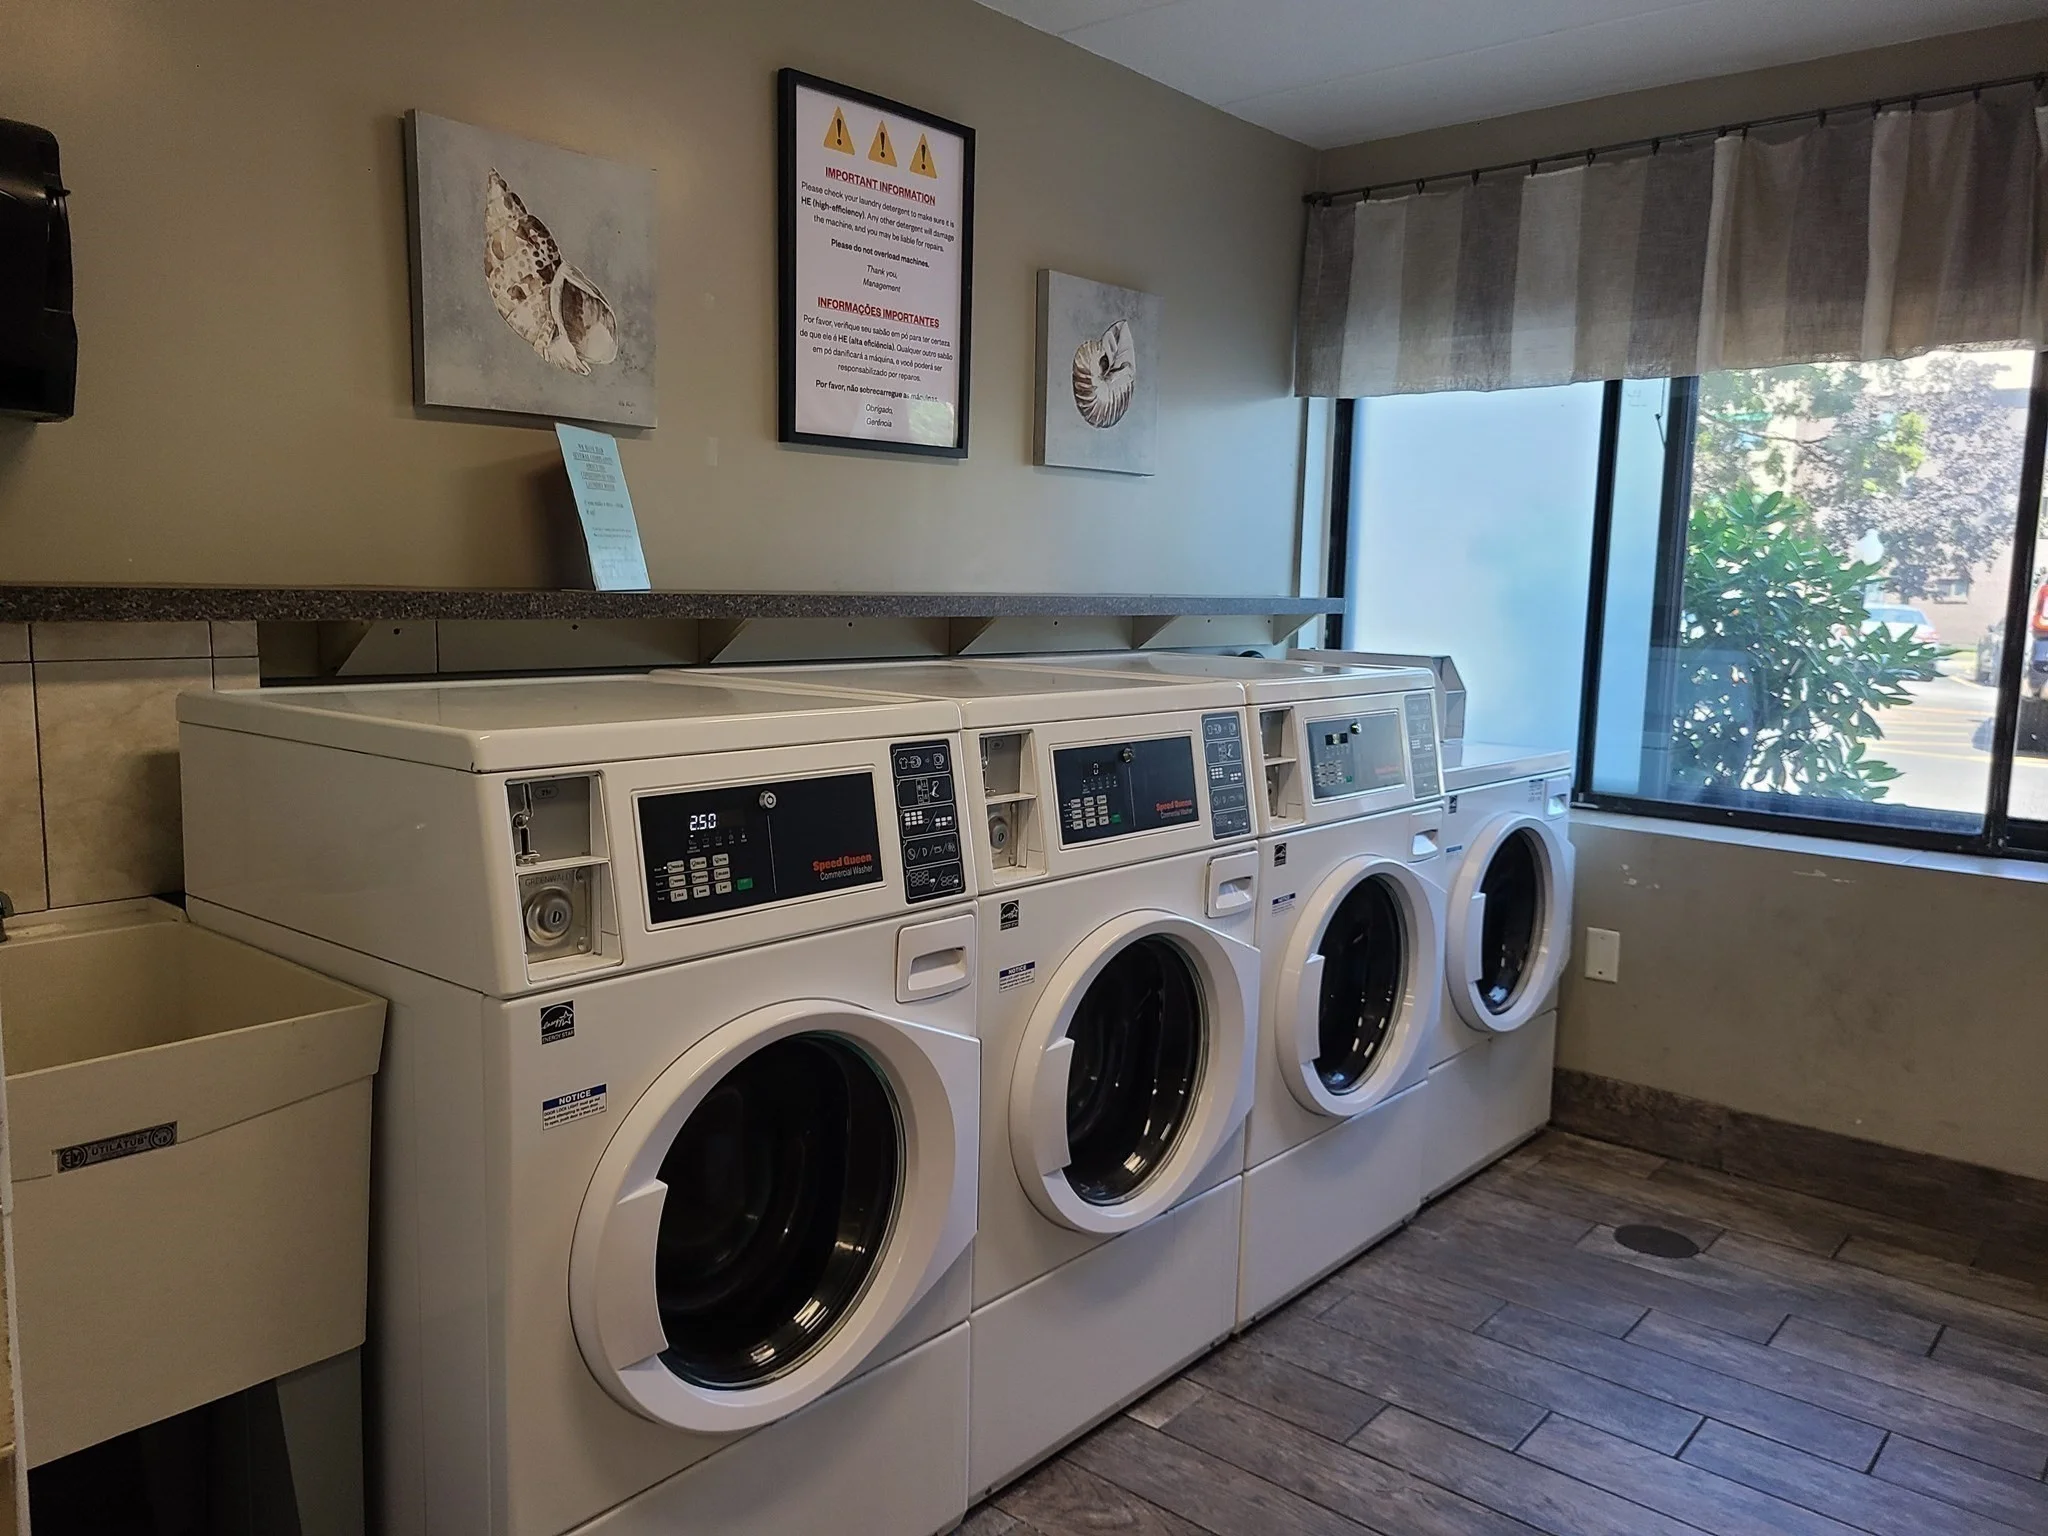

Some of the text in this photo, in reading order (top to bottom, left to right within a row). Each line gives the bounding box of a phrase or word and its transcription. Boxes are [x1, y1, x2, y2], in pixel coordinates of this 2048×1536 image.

[825, 167, 936, 206] IMPORTANT INFORMATION
[802, 181, 823, 194] Please
[824, 188, 843, 199] check
[845, 194, 858, 204] your
[859, 196, 881, 210] laundry
[882, 202, 910, 217] detergent
[918, 212, 932, 222] make
[933, 217, 945, 225] sure
[801, 197, 811, 206] HE
[867, 213, 878, 224] Any
[880, 215, 895, 226] other
[896, 219, 923, 235] detergent
[924, 226, 932, 236] will
[933, 229, 955, 242] damage
[814, 215, 824, 224] the
[826, 217, 853, 231] machine,
[855, 224, 866, 233] and
[867, 227, 878, 236] you
[879, 230, 891, 240] may
[892, 232, 899, 240] be
[900, 234, 915, 244] liable
[831, 239, 930, 268] Please do not overload machines.
[867, 265, 884, 275] Thank
[863, 278, 901, 293] Management
[818, 296, 939, 328] INFORMAÇÕES IMPORTANTES
[803, 315, 814, 324] Por
[816, 317, 833, 328] favor,
[834, 321, 860, 332] verifique
[873, 327, 890, 337] sabão
[901, 331, 908, 340] pó
[909, 335, 921, 343] para
[931, 338, 950, 347] certeza
[800, 329, 808, 337] de
[809, 332, 821, 340] que
[838, 335, 848, 343] HE
[849, 336, 862, 346] (alta
[897, 344, 921, 355] Qualquer
[922, 348, 936, 358] outro
[937, 350, 953, 360] sabão
[824, 346, 832, 356] pó
[833, 348, 863, 360] danificará
[900, 359, 913, 368] você
[838, 364, 887, 377] responsabilizado
[888, 371, 897, 379] por
[816, 380, 827, 388] Por
[828, 381, 845, 392] favor,
[847, 384, 858, 392] não
[860, 387, 902, 399] sobrecarregue
[690, 813, 716, 831] 2.50
[813, 854, 872, 872] Speed Queen
[820, 865, 872, 880] Commercial Washer
[1008, 964, 1027, 975] NOTICE
[558, 1090, 591, 1105] NOTICE
